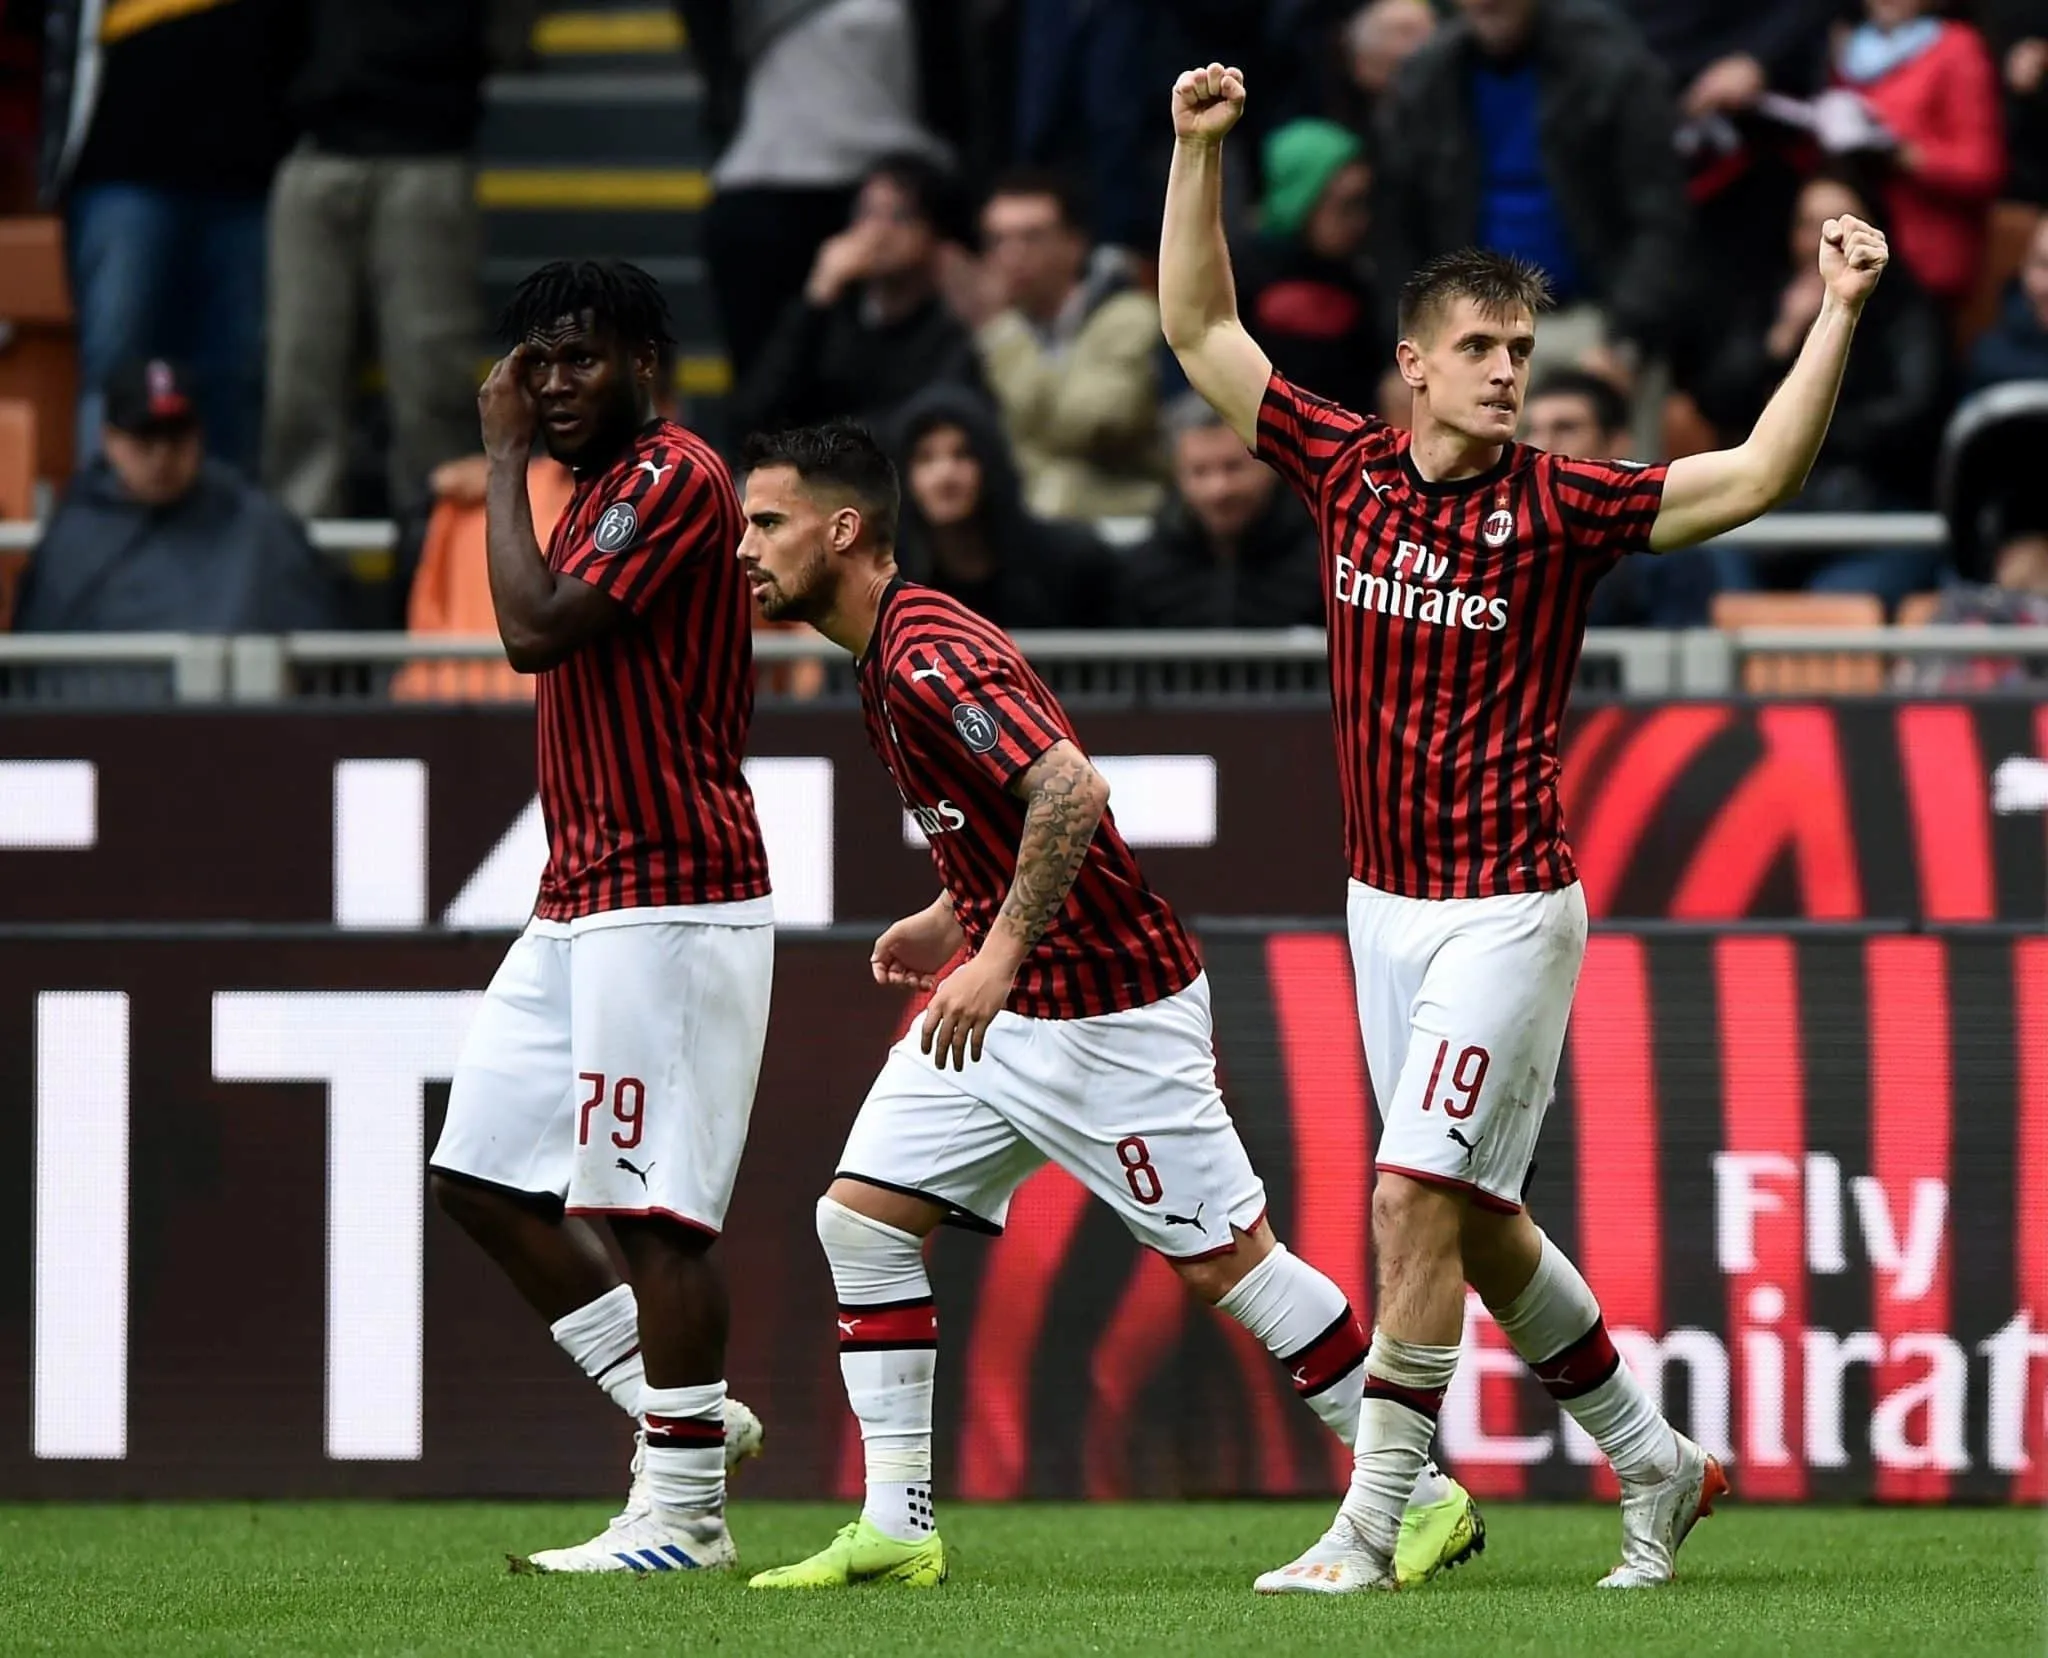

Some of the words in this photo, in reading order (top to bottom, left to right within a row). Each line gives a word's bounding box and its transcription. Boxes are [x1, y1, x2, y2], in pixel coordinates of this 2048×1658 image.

[1335, 555, 1508, 632] Emirates
[1392, 540, 1449, 583] Fly
[579, 1072, 645, 1149] 79
[1422, 1039, 1490, 1119] 19
[1116, 1136, 1163, 1204] 8
[1712, 1150, 1949, 1301] Fly
